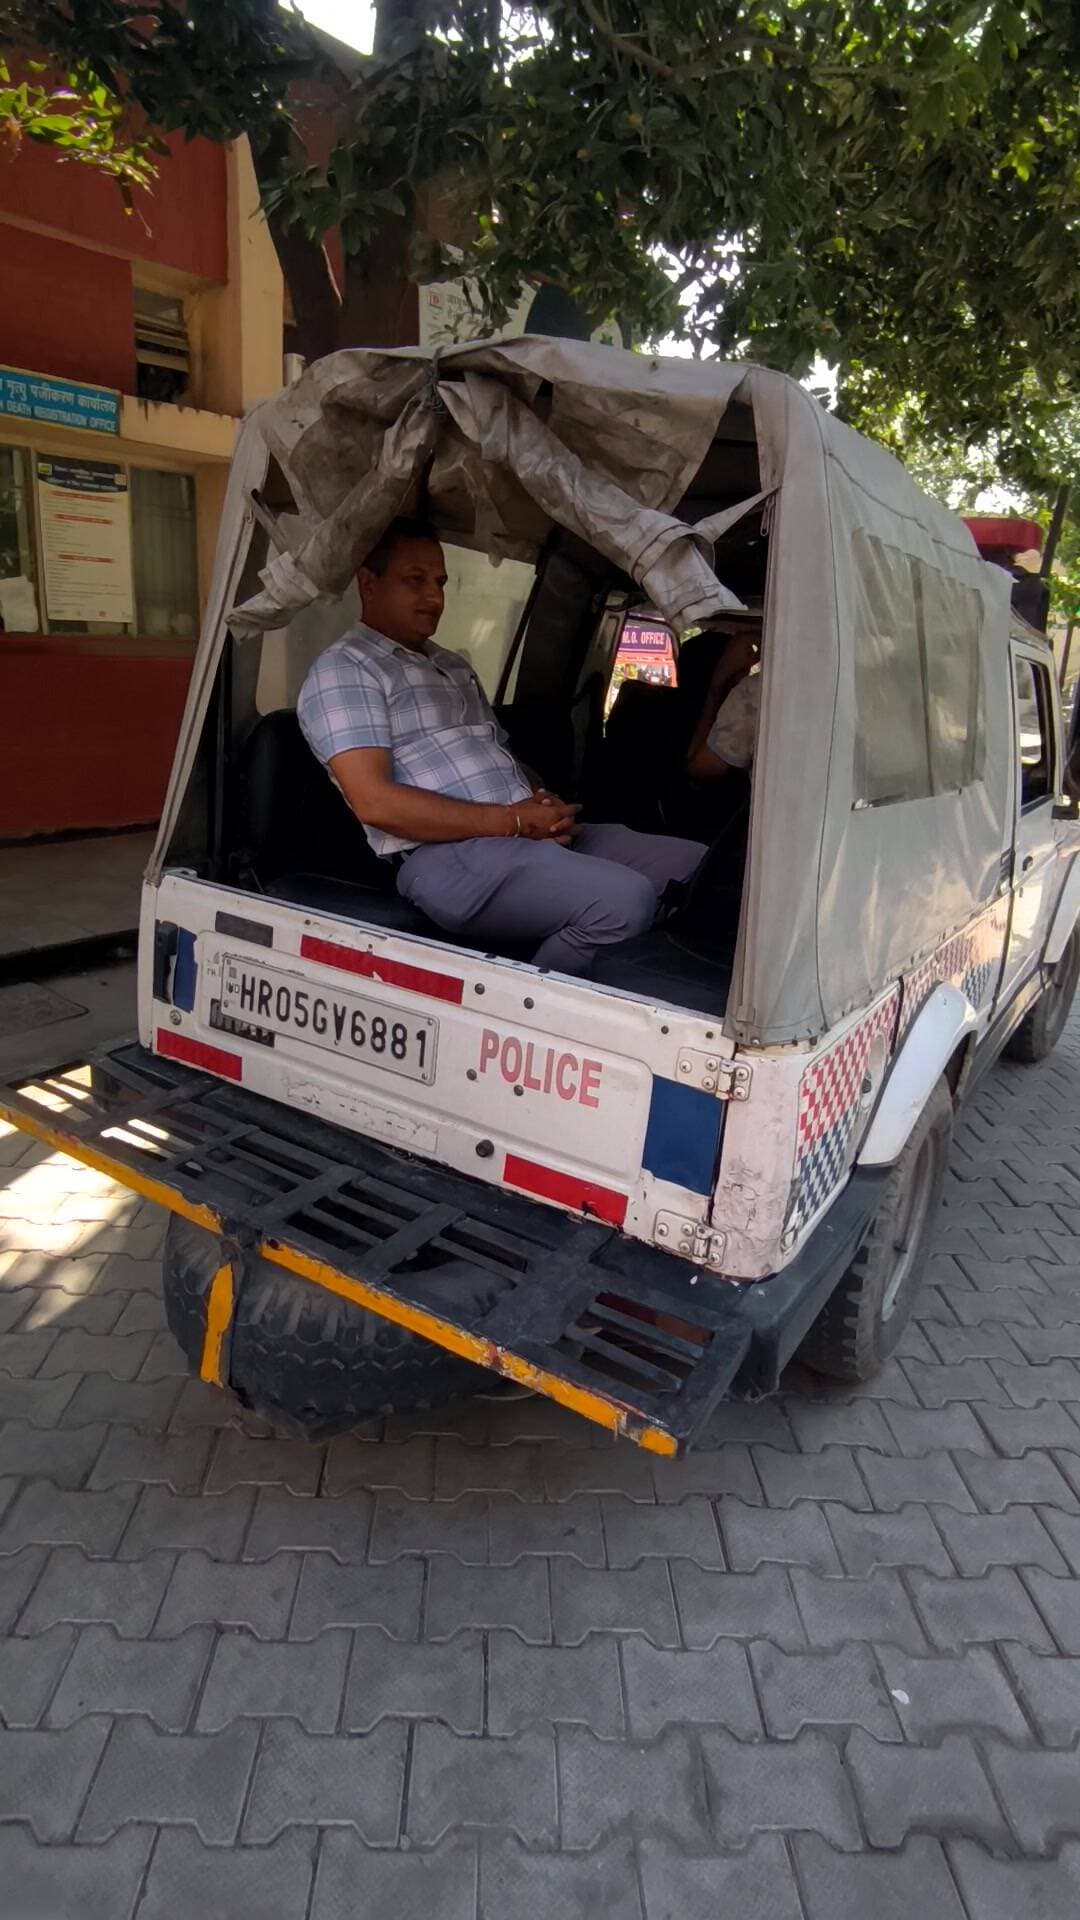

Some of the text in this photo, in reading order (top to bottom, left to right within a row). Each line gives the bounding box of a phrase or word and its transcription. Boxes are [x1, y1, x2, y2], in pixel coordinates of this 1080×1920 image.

[6, 400, 32, 417] DEATH
[34, 405, 87, 426] REGISTRATION
[89, 416, 117, 432] OFFICE
[77, 393, 117, 414] कार्यालय
[640, 631, 665, 645] OFFICE
[240, 973, 427, 1068] HR05GV6881
[480, 1028, 603, 1109] POLICE
